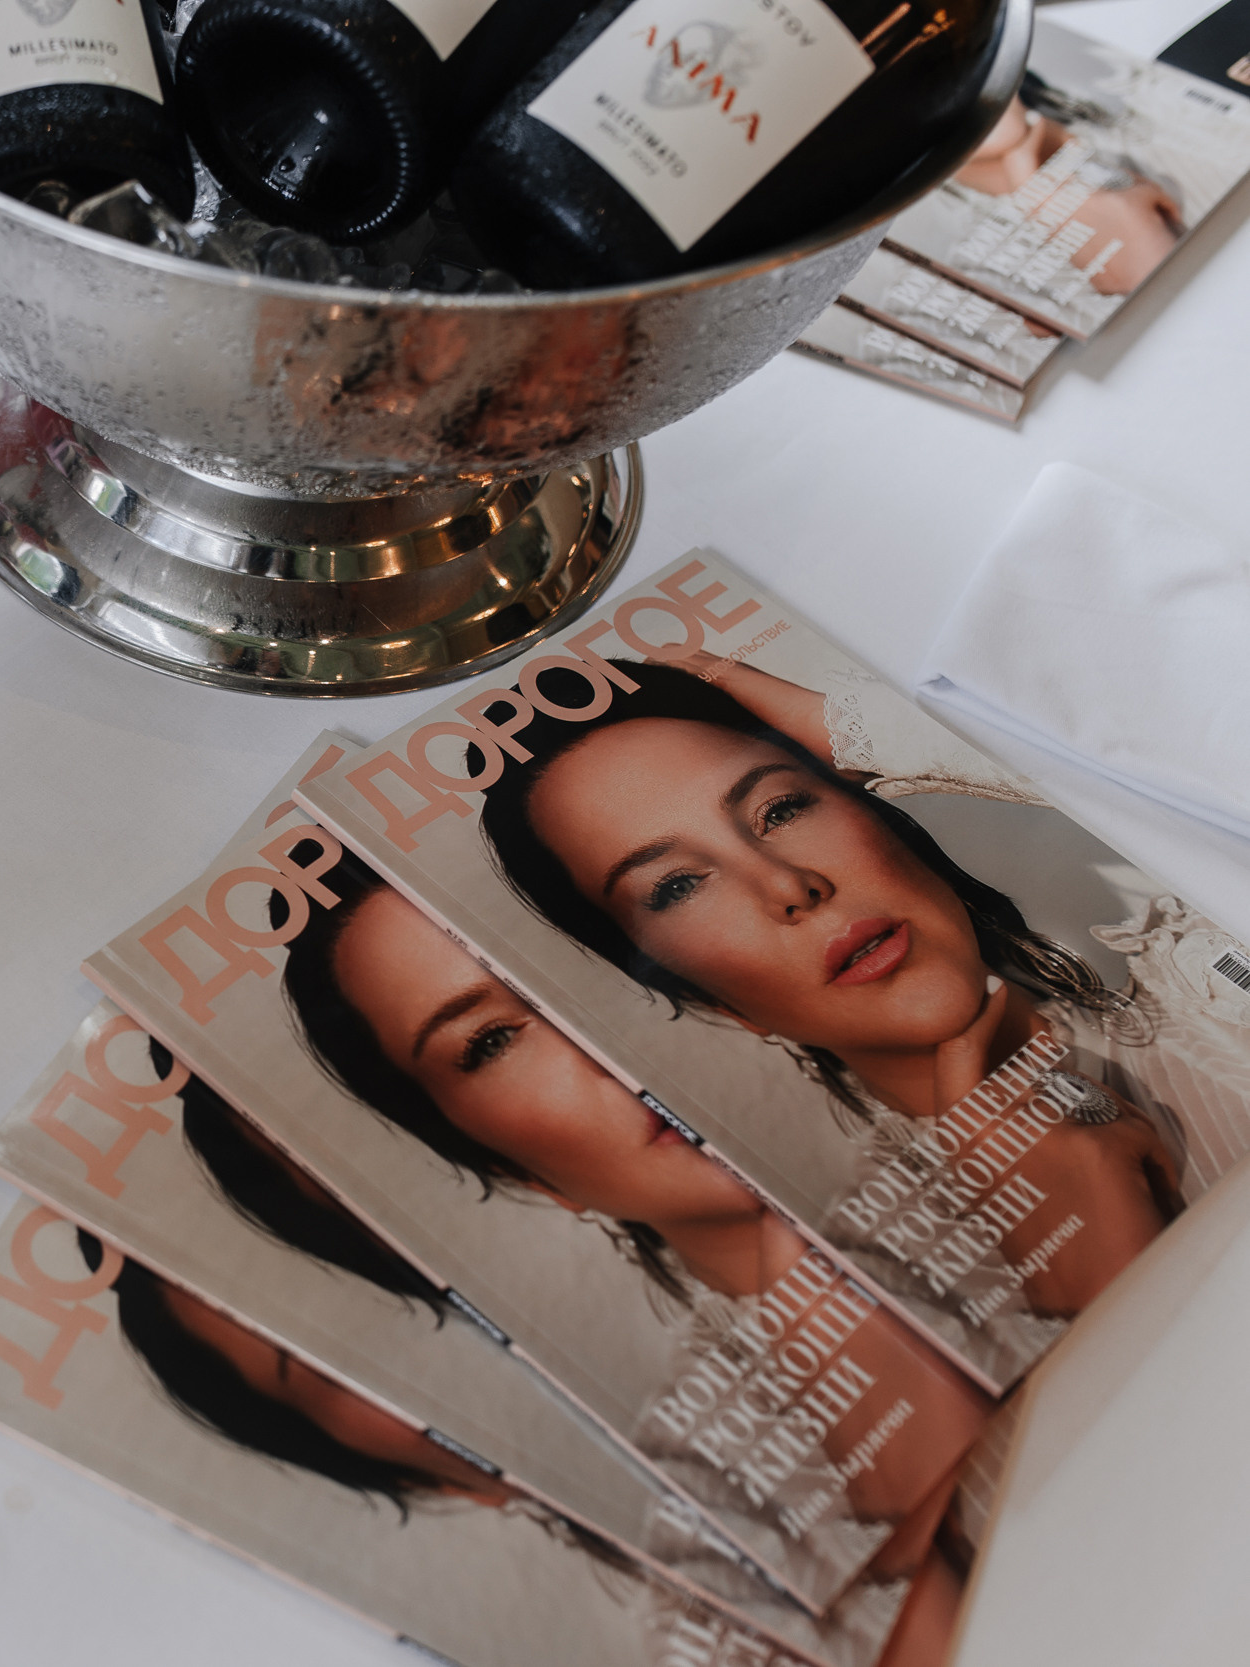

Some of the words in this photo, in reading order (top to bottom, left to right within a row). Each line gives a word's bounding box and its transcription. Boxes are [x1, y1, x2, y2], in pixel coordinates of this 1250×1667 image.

[9, 38, 119, 57] MILLESIMATO
[630, 25, 760, 145] ANIMA
[345, 560, 762, 853] ДОРОГОЕ
[698, 619, 792, 682] УДОВОЛЬСТВИЕ
[838, 1030, 1070, 1233] ВОПЛОЩЕНИЕ
[875, 1072, 1087, 1263] РОСКОШНОЙ
[911, 1172, 1050, 1298] ЖИЗНИ
[726, 1356, 878, 1510] ЖИЗНИ
